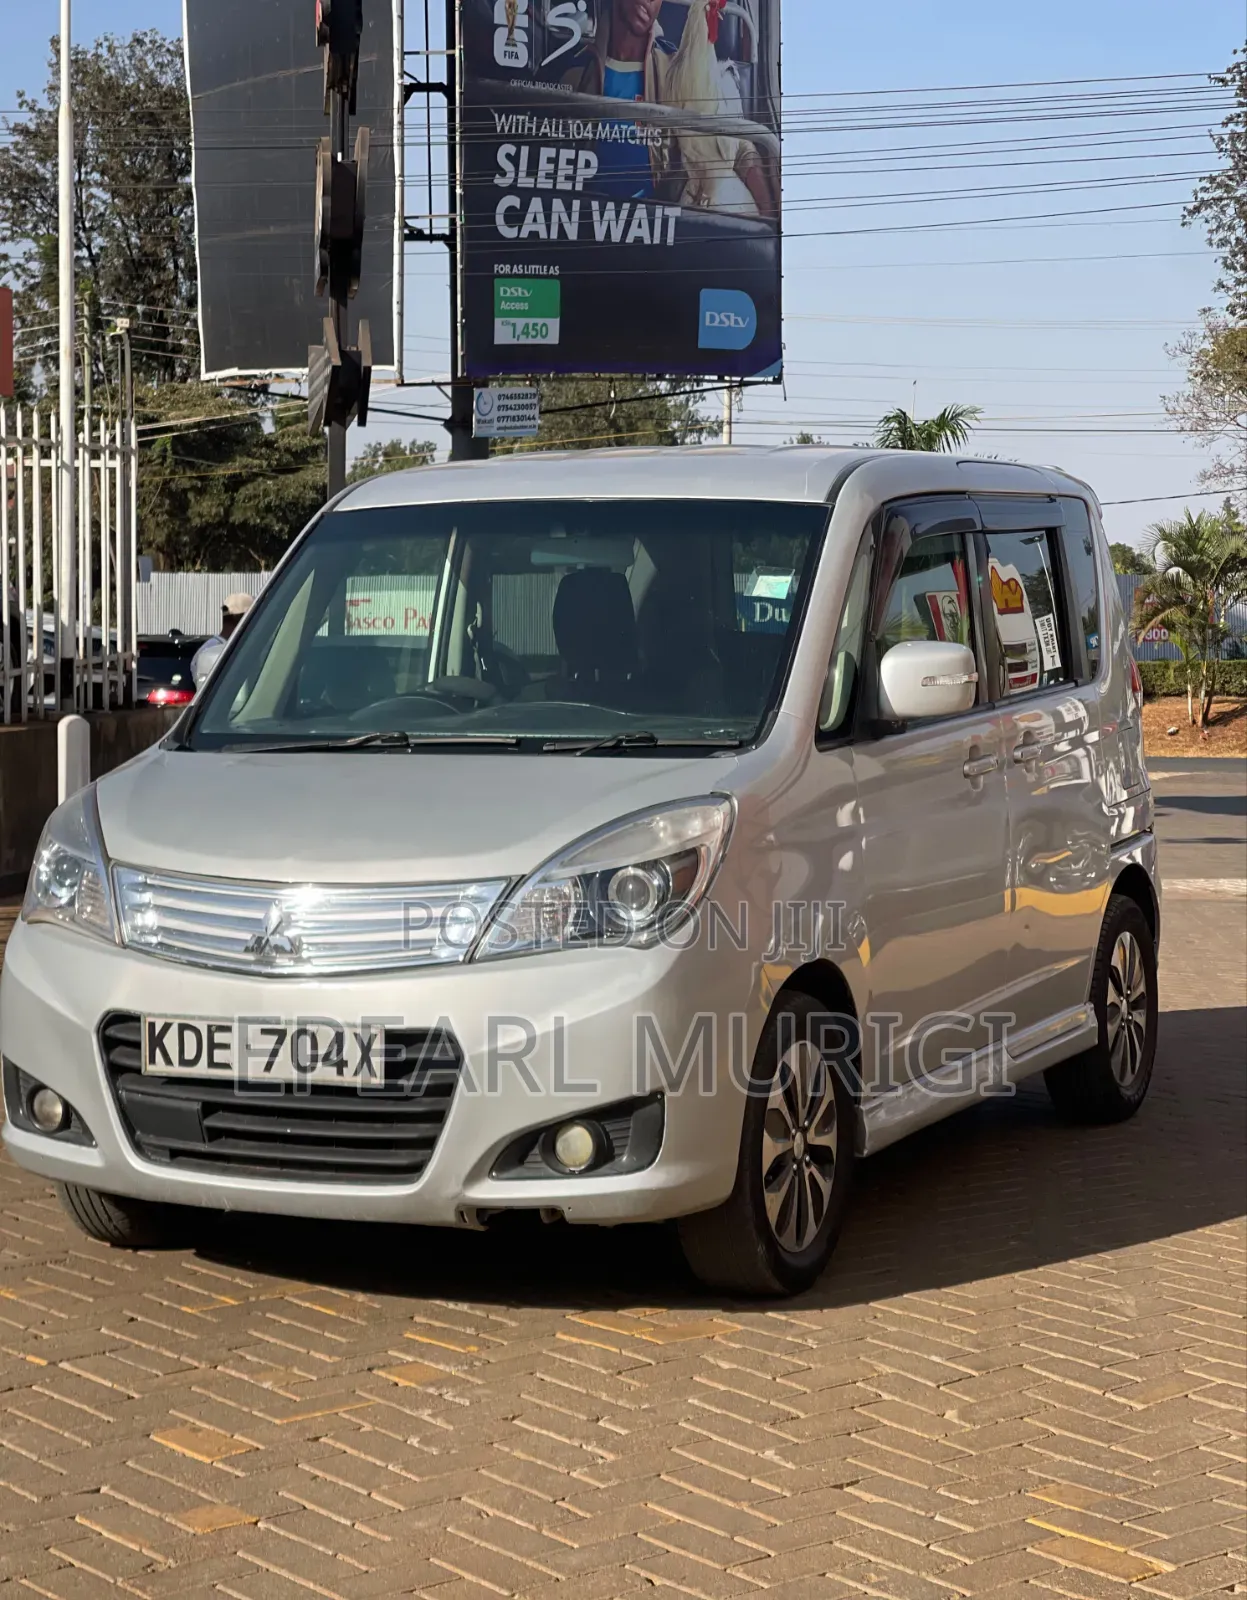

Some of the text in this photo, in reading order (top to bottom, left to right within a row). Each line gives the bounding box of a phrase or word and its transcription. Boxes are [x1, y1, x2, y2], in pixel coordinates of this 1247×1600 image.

[503, 50, 520, 60] FIFA
[510, 79, 534, 88] OFFICIAL
[494, 113, 536, 136] WITH
[539, 118, 565, 138] ALL
[568, 120, 594, 140] 104
[494, 144, 599, 191] SLEEP
[495, 195, 682, 246] CAN WAIT
[494, 264, 560, 276] FOR AS LITTLE AS
[500, 287, 533, 297] DStv
[500, 301, 529, 311] Access
[705, 311, 750, 328] DStv
[511, 322, 549, 341] 1,450
[148, 1021, 379, 1079] KDE 704X
